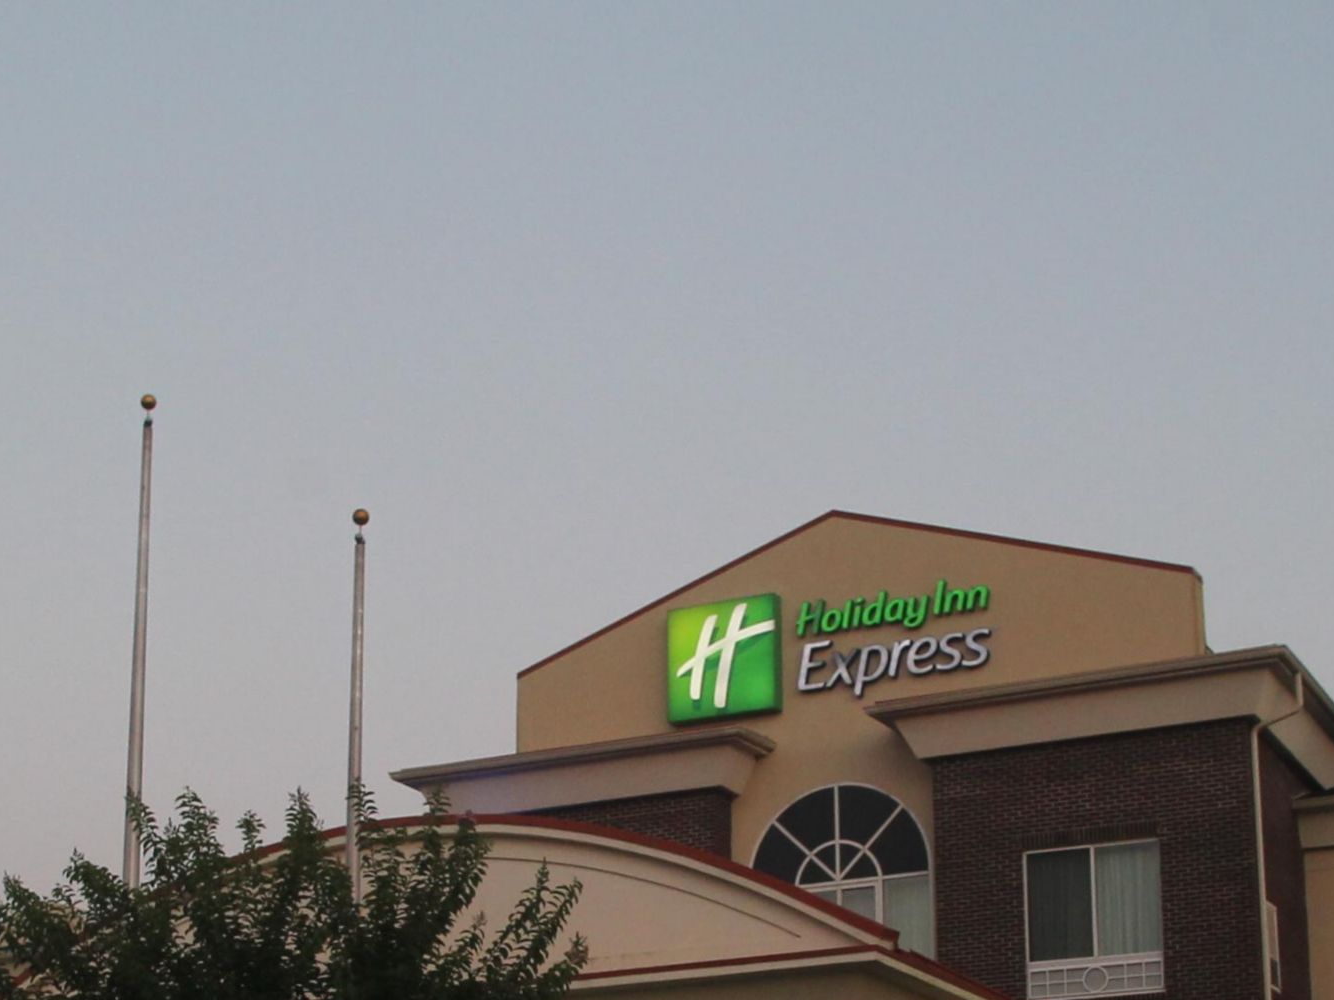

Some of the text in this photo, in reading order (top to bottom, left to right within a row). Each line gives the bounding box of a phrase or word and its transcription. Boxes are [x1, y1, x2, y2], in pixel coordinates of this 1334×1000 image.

[795, 579, 989, 637] Holiday Inn
[676, 602, 776, 709] H
[797, 628, 992, 697] Express
